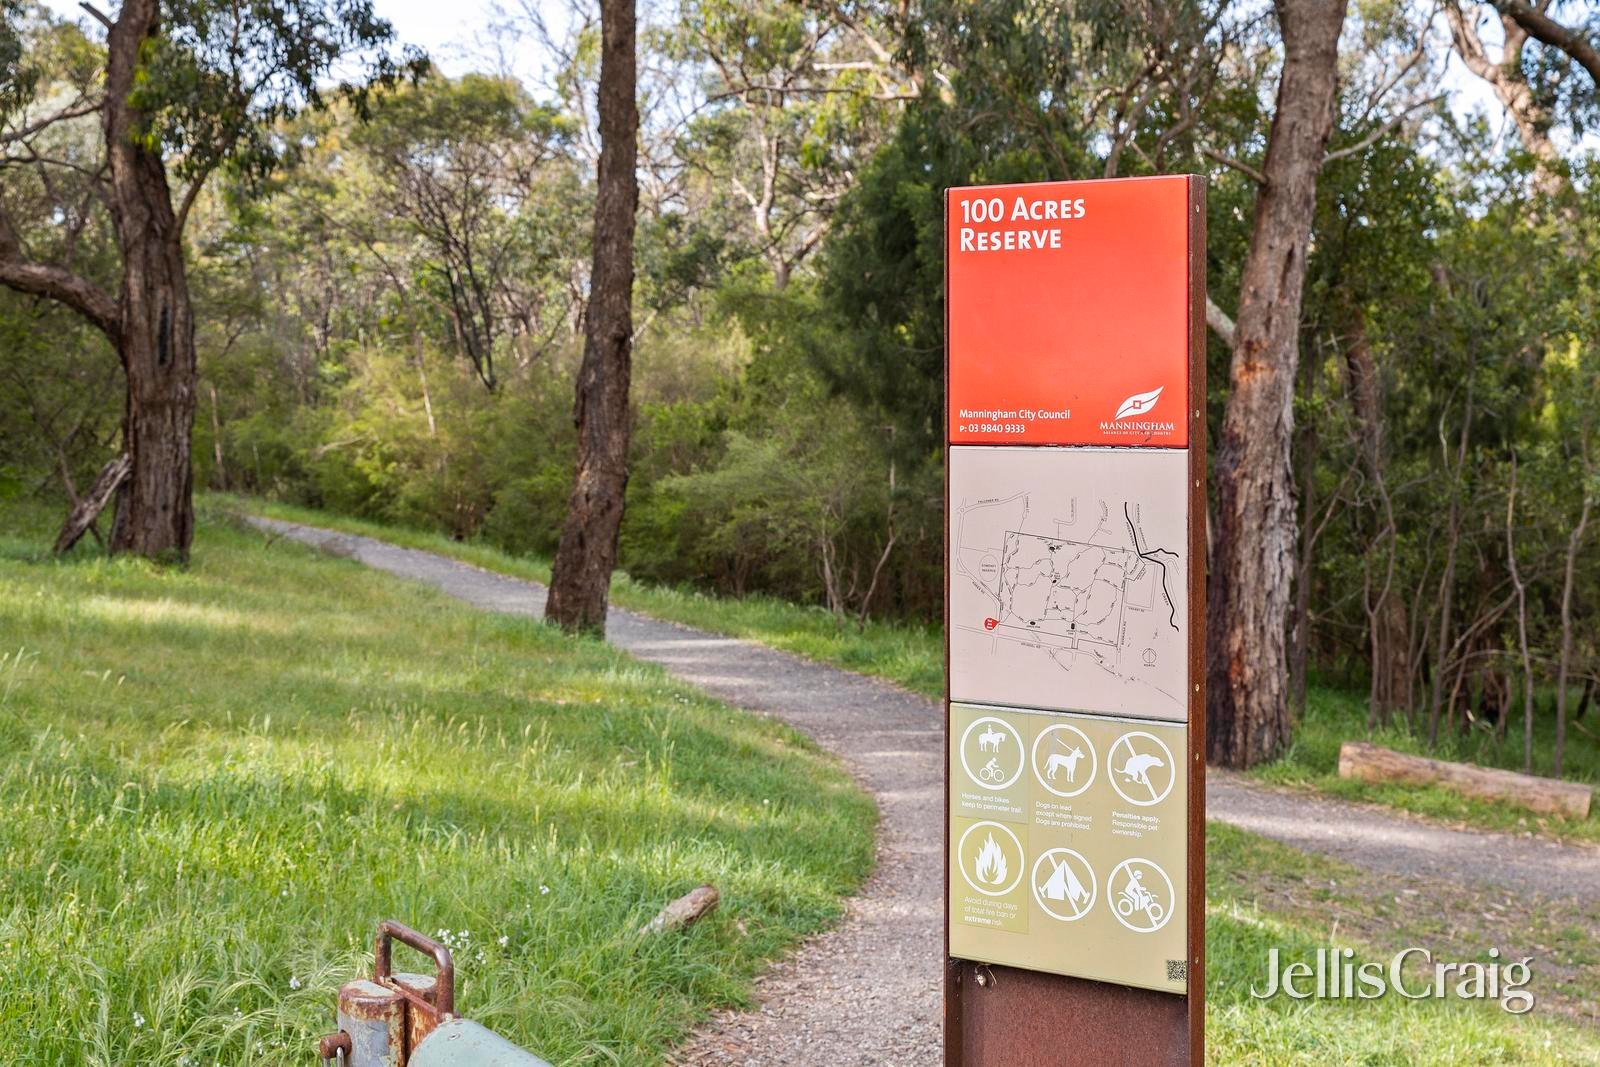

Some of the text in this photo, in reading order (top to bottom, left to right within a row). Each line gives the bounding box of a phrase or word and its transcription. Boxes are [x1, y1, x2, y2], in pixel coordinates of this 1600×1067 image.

[960, 197, 1004, 223] 100
[959, 409, 1071, 421] Manningham City Council
[968, 423, 979, 433] 03
[981, 423, 1003, 433] 9840
[1005, 424, 1026, 434] 9333
[1099, 421, 1175, 431] MANNINGHAM
[961, 792, 982, 800] Horses
[994, 796, 1010, 804] bikes
[961, 801, 976, 809] keep
[983, 803, 1009, 812] perimeter
[1035, 801, 1051, 810] Dogs
[1059, 803, 1072, 811] lead
[1035, 810, 1054, 818] except
[1112, 811, 1141, 820] Penalties
[1035, 817, 1051, 826] Dogs
[1112, 820, 1147, 830] Responsible
[964, 896, 1018, 911] Avoid during days
[971, 906, 985, 914] total
[996, 910, 1009, 918] ban
[964, 915, 991, 925] extreme
